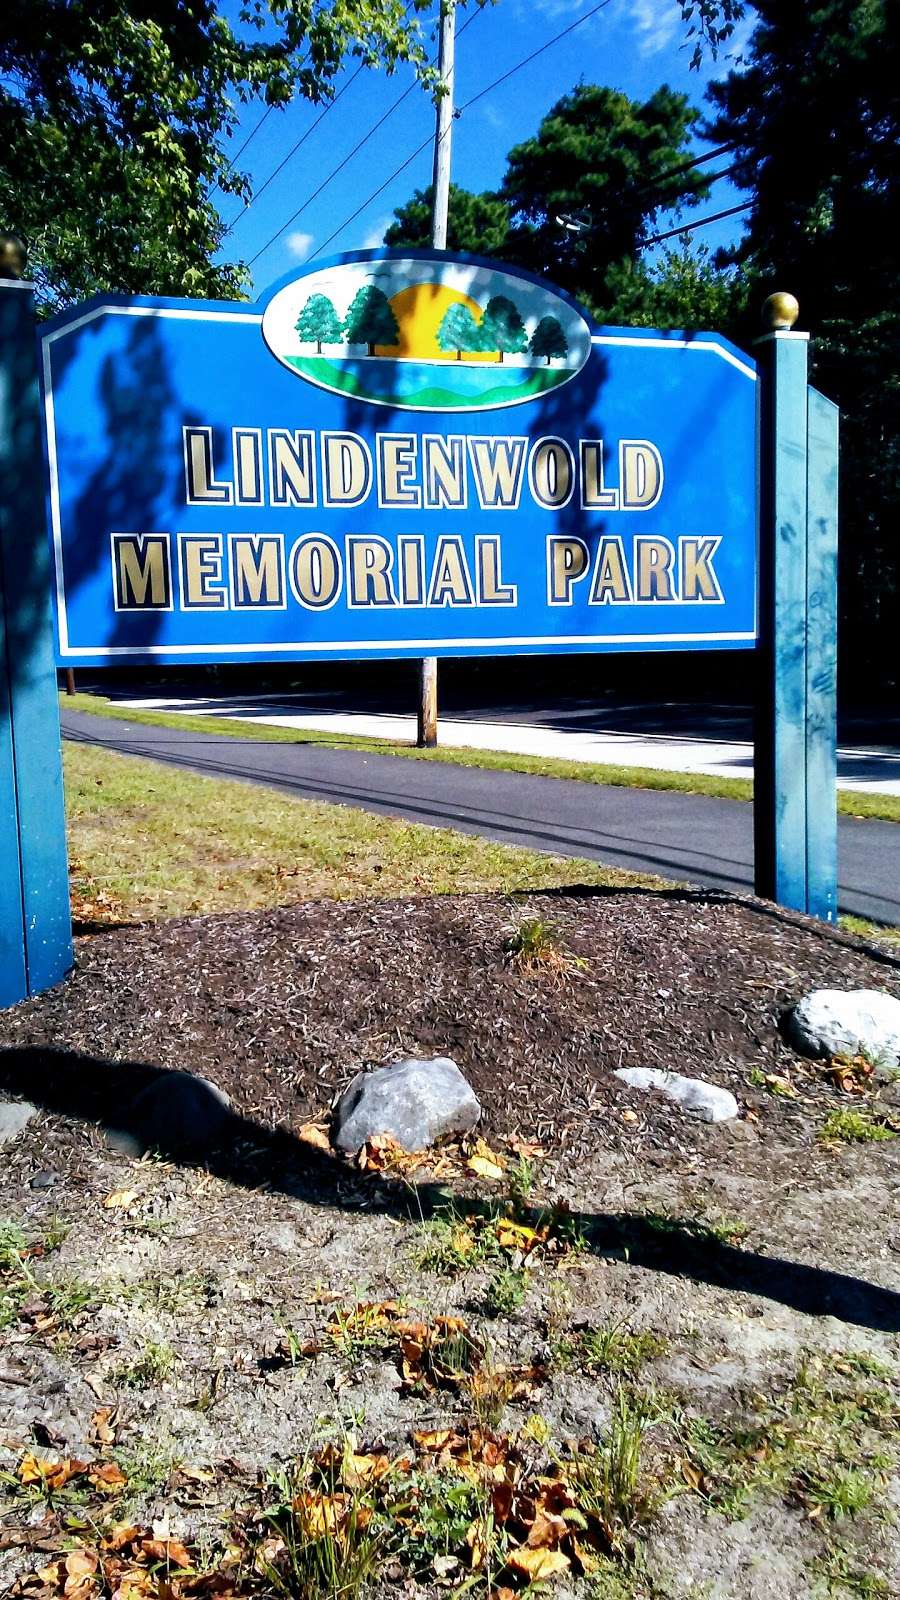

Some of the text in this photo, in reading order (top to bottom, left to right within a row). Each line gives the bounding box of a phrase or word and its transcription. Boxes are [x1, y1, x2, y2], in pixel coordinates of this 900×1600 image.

[182, 426, 664, 511] LINDENWOLD
[110, 532, 726, 613] MEMORIAL PARK
